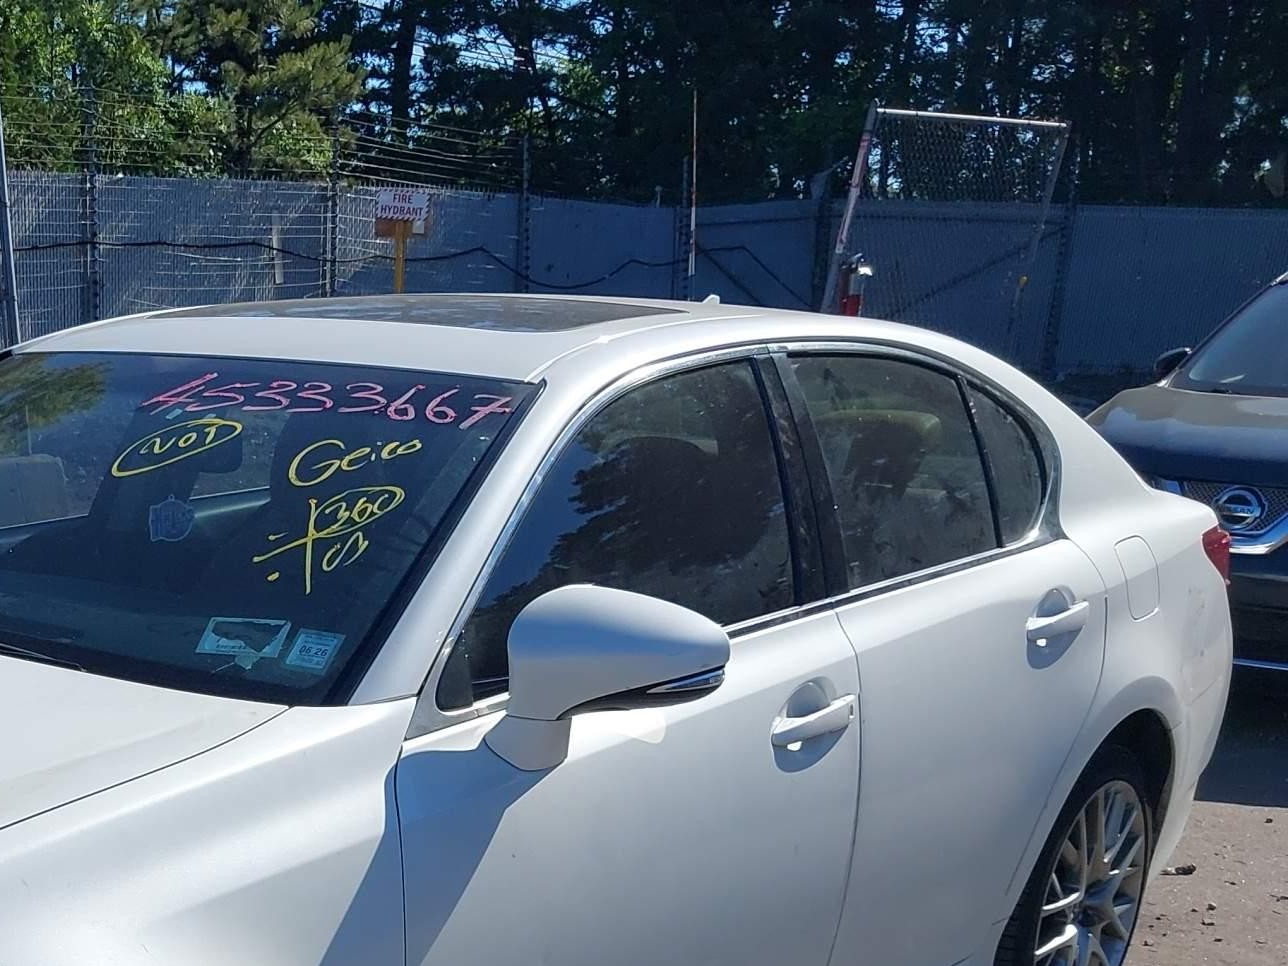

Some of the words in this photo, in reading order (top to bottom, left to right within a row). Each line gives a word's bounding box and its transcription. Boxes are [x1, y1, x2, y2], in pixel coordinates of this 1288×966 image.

[380, 205, 424, 216] HYDRANT
[392, 193, 414, 204] FIRE
[142, 372, 512, 430] 45333667
[287, 438, 423, 487] Geico
